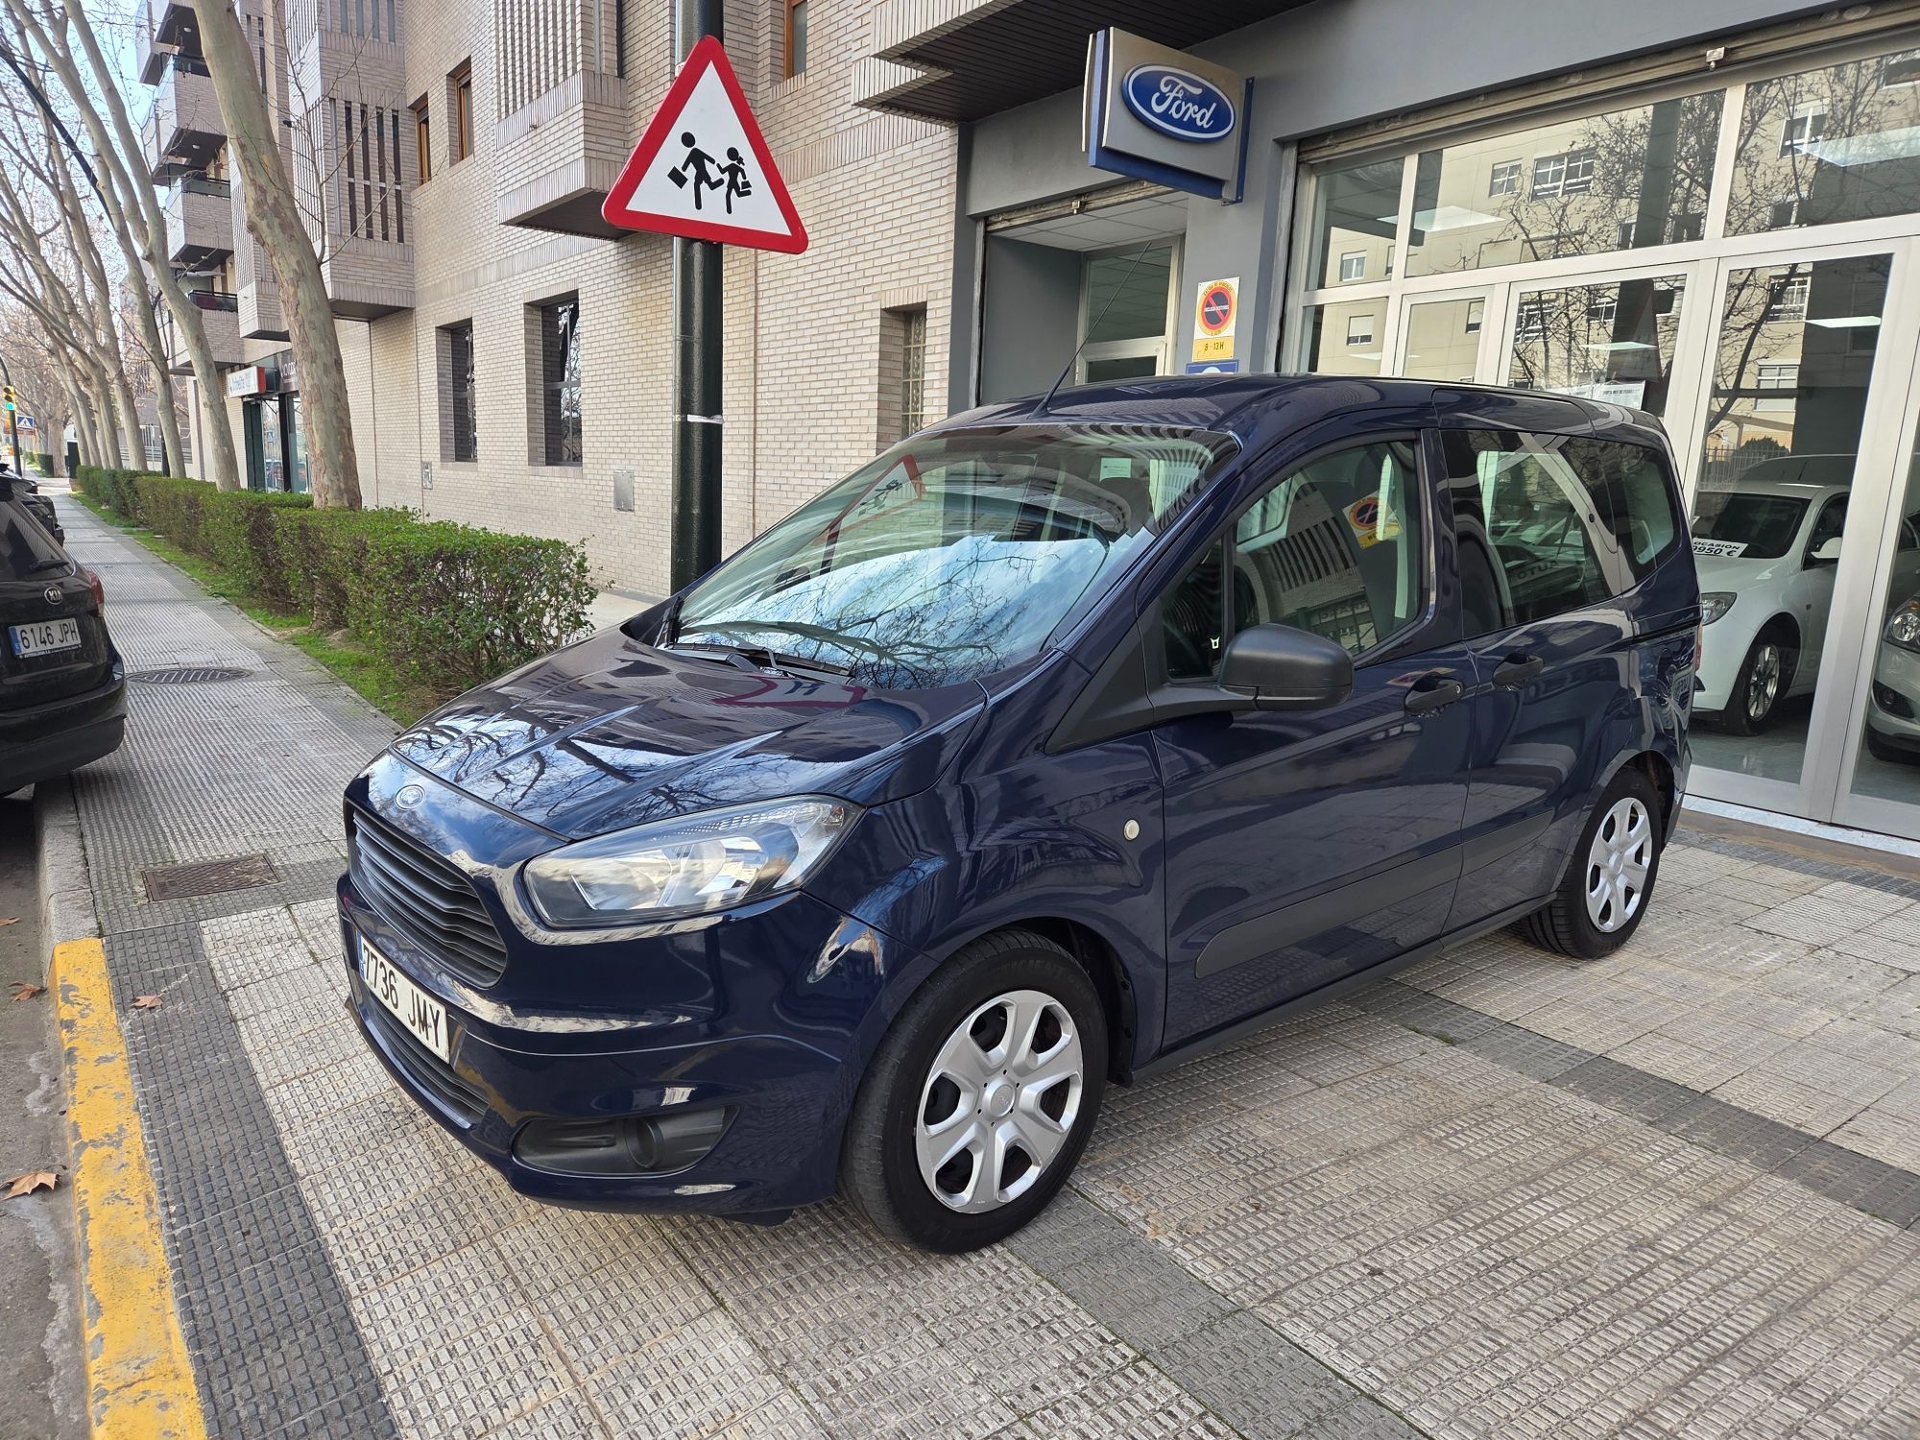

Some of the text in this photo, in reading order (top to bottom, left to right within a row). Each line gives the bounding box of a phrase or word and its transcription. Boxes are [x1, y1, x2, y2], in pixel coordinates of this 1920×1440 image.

[1151, 75, 1217, 129] Ford
[1693, 541, 1741, 550] OCASION
[1726, 549, 1737, 557] €
[20, 621, 79, 649] 6146 JPH
[363, 944, 441, 1049] 7736 JMY
